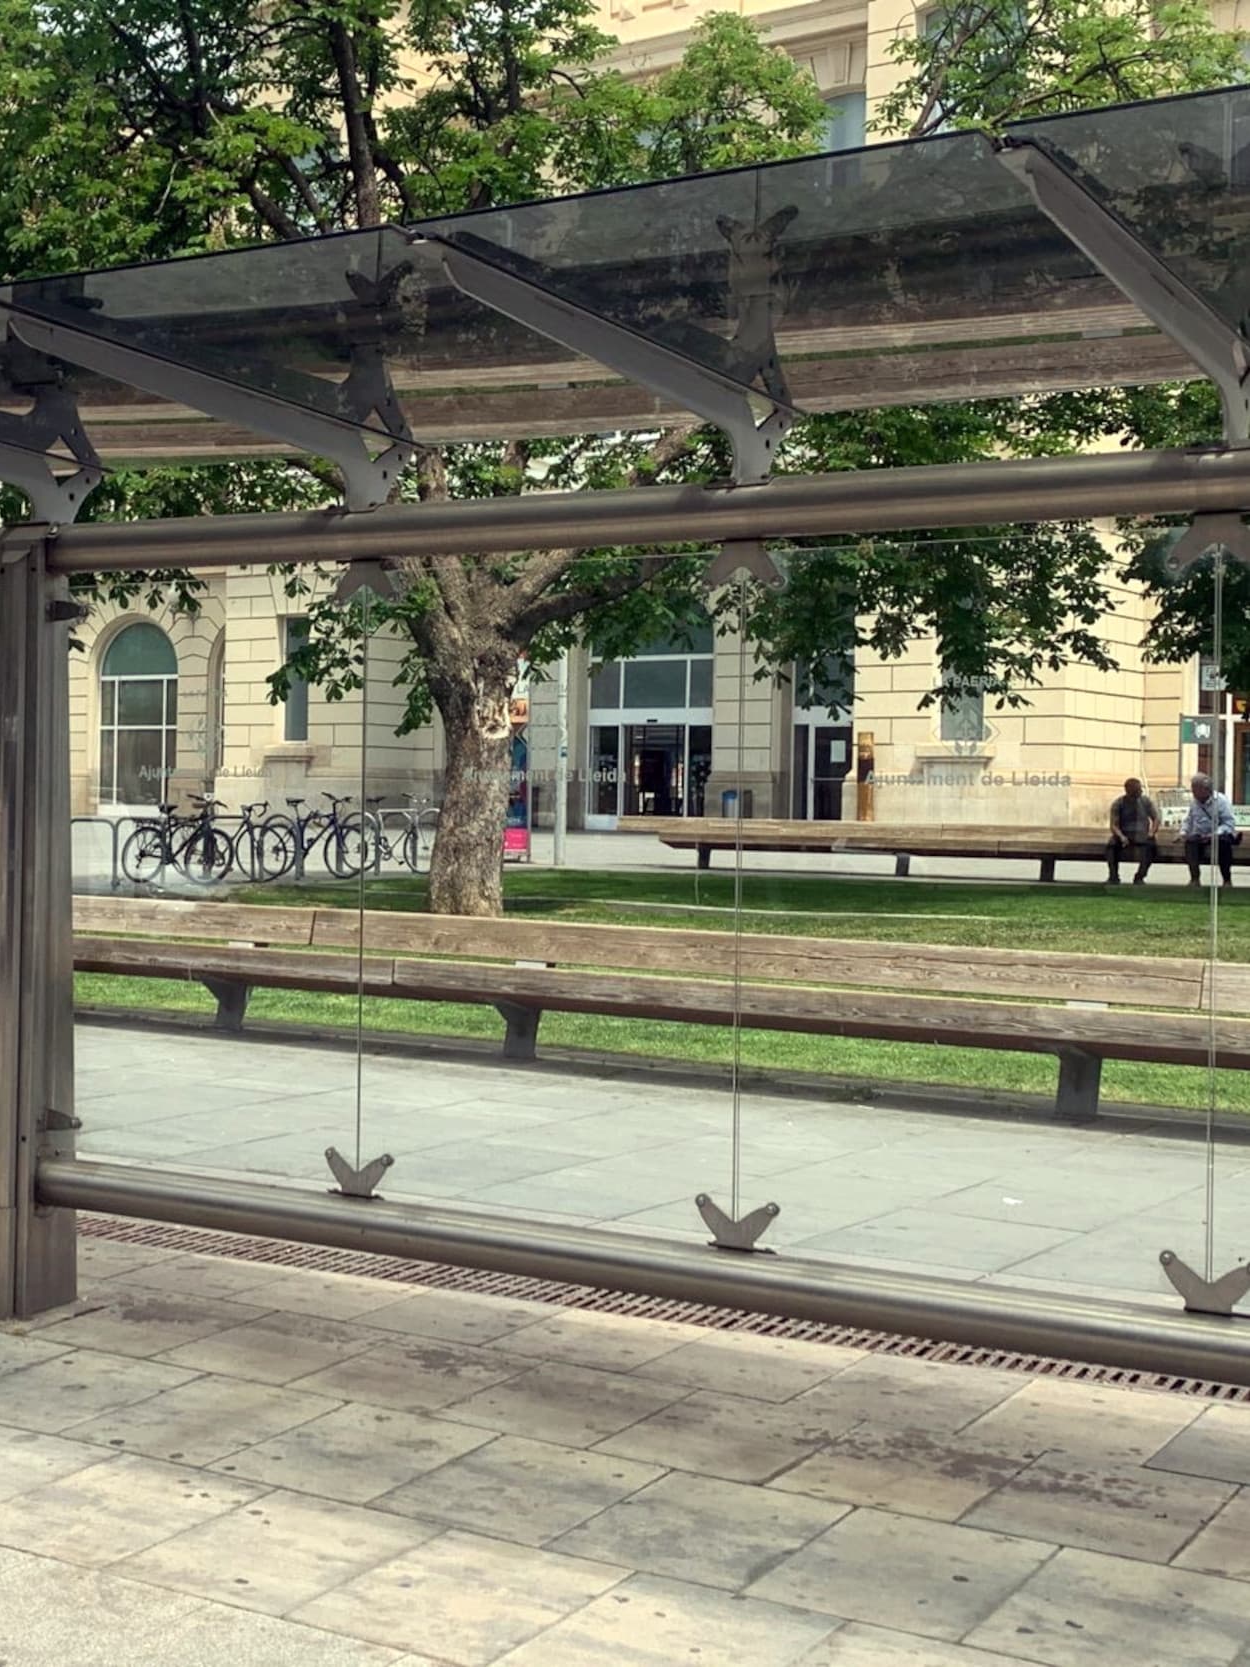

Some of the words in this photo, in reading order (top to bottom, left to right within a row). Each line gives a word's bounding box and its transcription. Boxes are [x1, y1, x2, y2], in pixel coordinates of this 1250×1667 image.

[578, 767, 627, 783] Lleida
[981, 769, 1004, 787] de
[1012, 769, 1071, 787] Lleida
